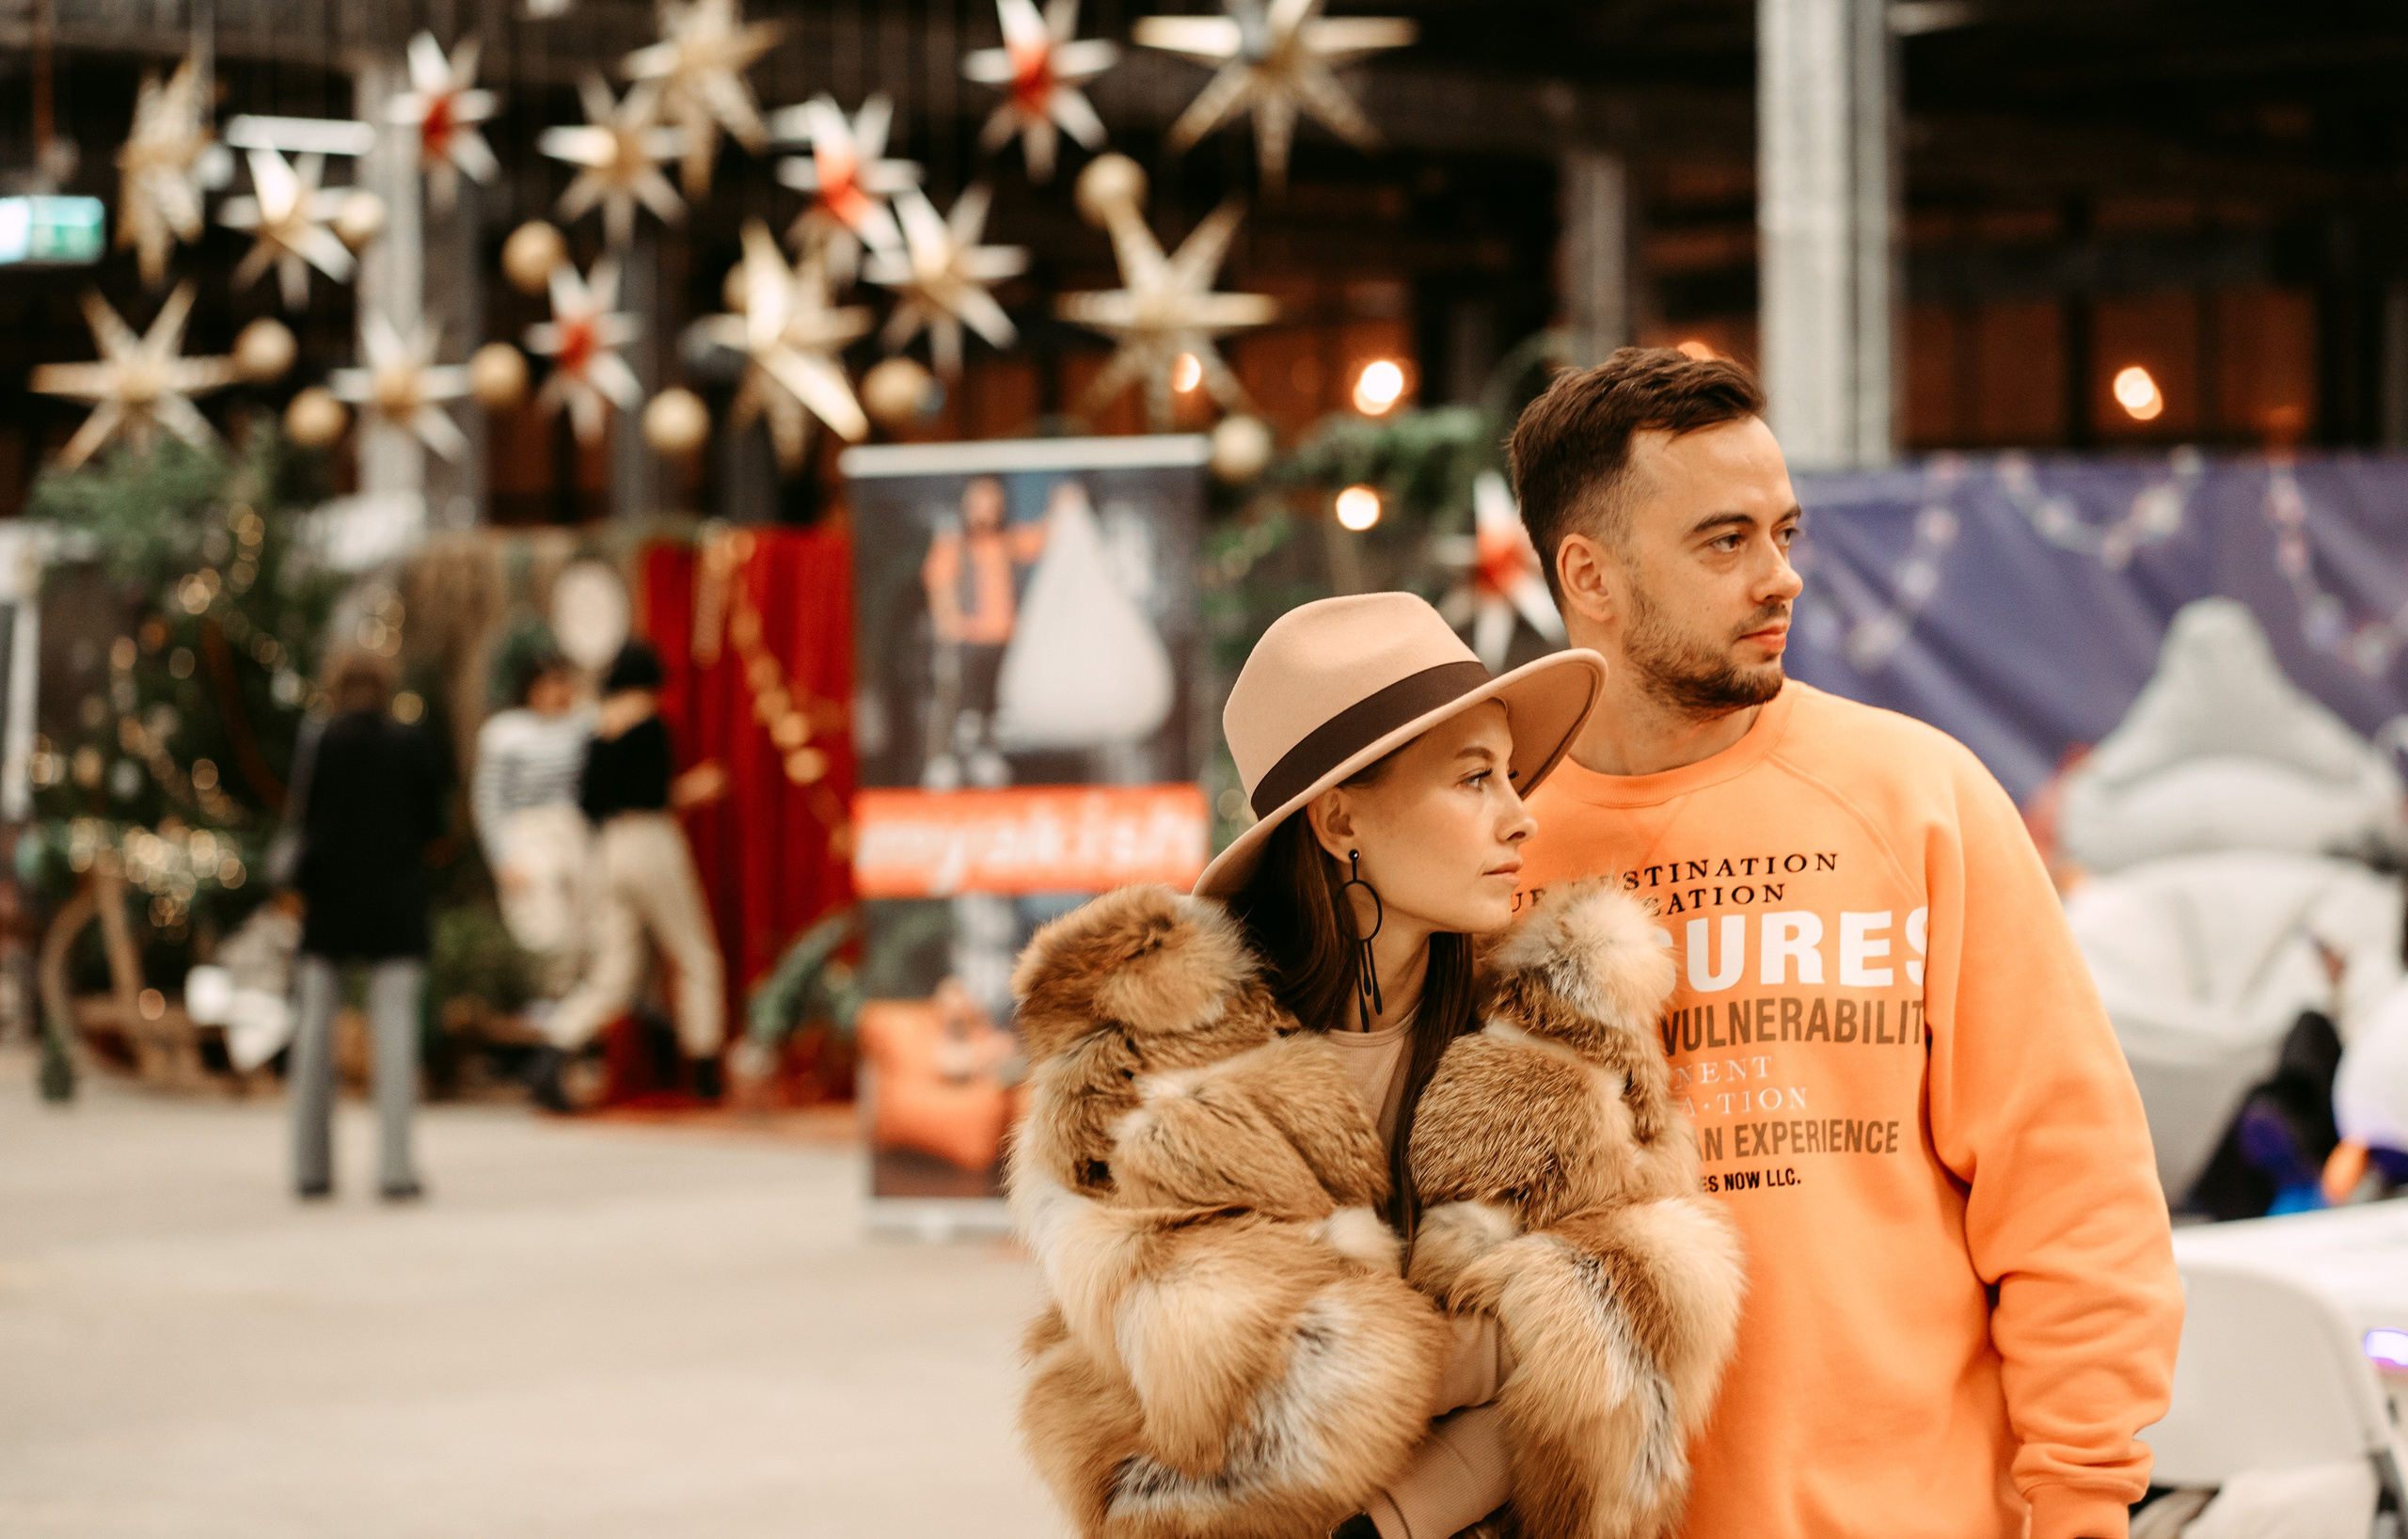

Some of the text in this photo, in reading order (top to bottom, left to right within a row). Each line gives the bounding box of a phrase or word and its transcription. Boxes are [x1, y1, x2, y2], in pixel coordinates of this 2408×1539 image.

[1569, 852, 1837, 890] STINATION
[1735, 1119, 1899, 1157] EXPERIENCE
[1723, 1170, 1761, 1192] NOW
[1766, 1167, 1802, 1187] LLC.
